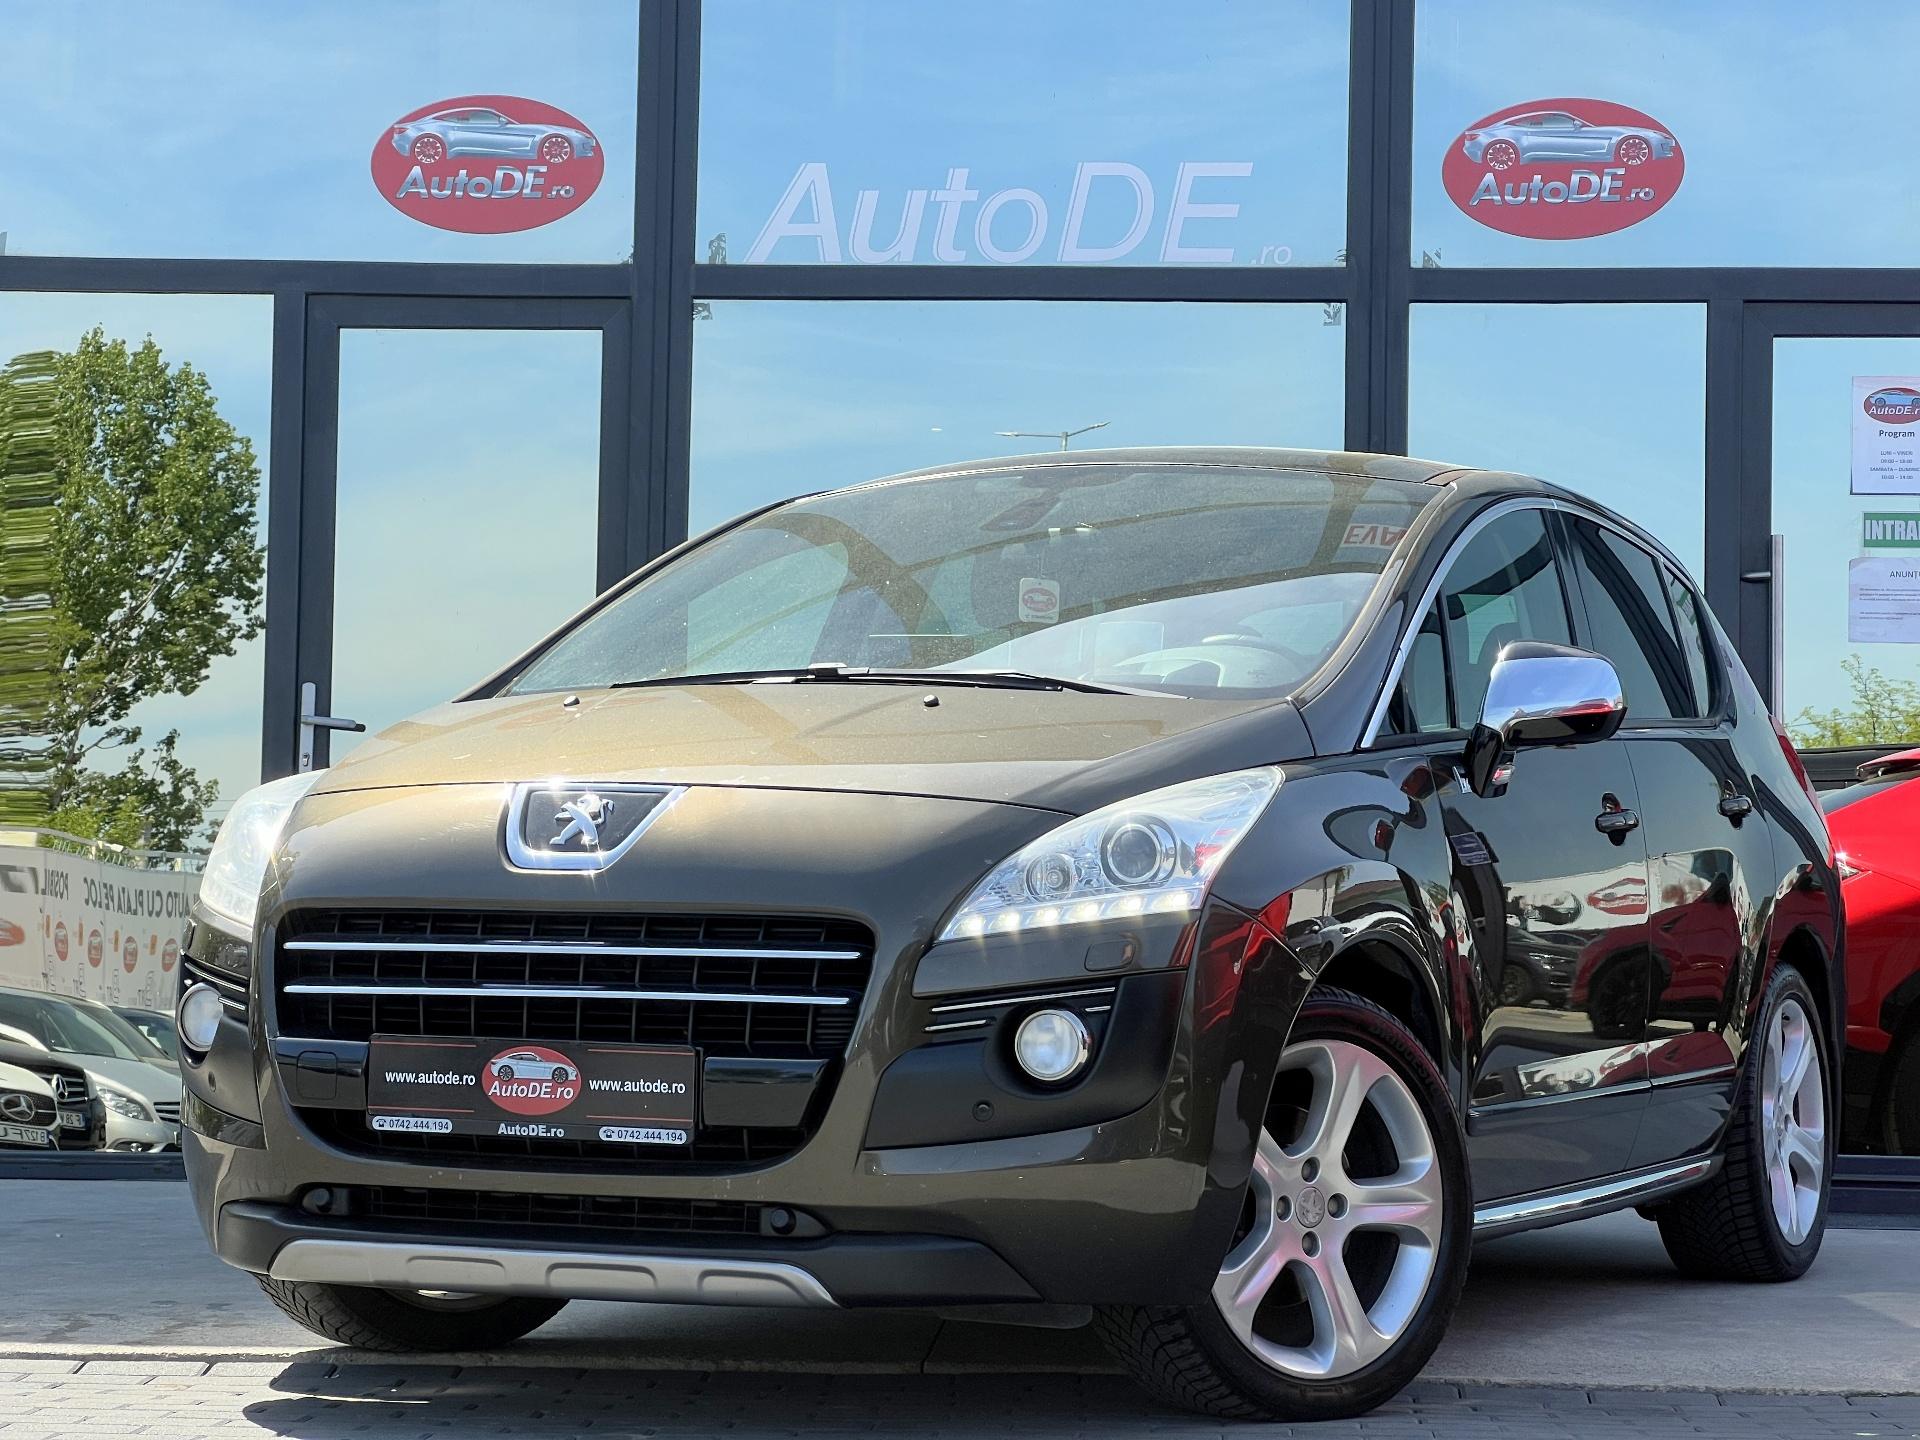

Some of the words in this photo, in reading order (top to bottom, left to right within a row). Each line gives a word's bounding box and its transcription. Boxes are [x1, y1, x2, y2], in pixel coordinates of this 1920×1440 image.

[1879, 429, 1915, 439] Program
[1864, 519, 1920, 540] INTRA
[1889, 570, 1920, 580] ANUNȚ
[385, 1069, 476, 1086] www.autode.ro
[589, 1077, 686, 1094] www.autode.ro
[487, 1079, 575, 1100] AutoDE.ro
[388, 1118, 449, 1131] 0742.444.194
[497, 1122, 565, 1138] AutoDE.ro
[616, 1129, 683, 1142] 0742.444.194
